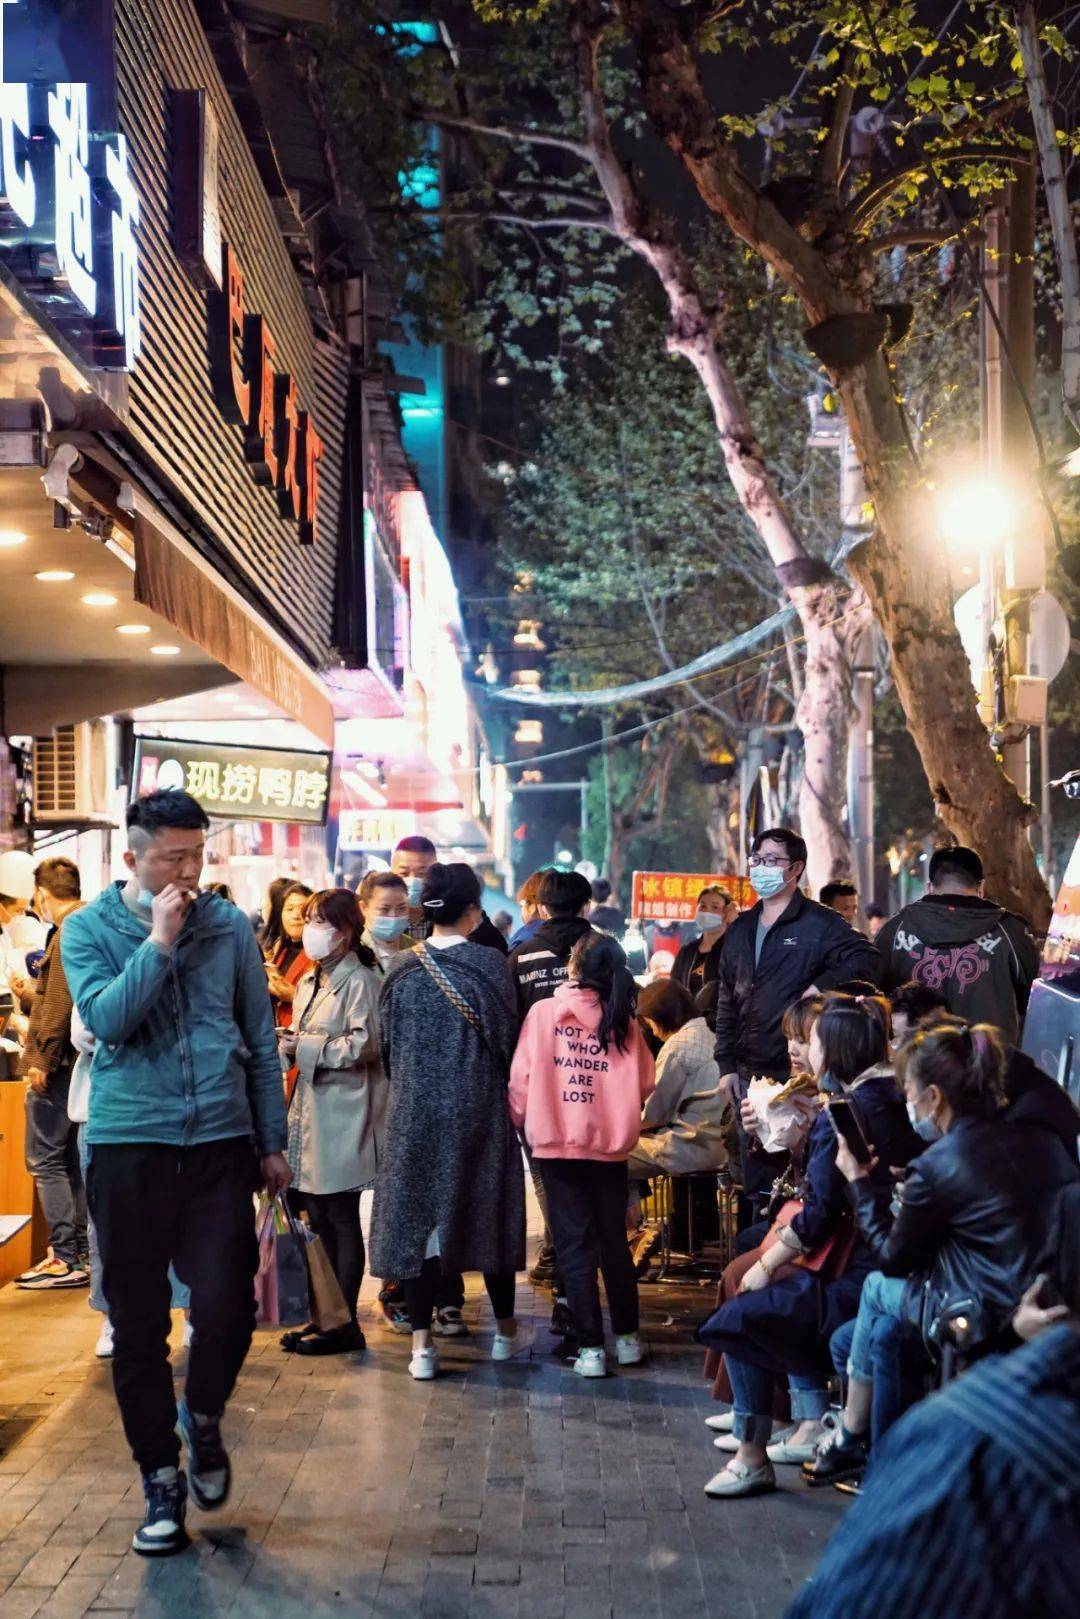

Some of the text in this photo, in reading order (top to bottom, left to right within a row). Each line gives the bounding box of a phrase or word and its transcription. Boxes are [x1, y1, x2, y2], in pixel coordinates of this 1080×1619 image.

[186, 761, 328, 809] 现捞鸭脖
[555, 1026, 583, 1038] NOT
[568, 1041, 600, 1055] WHO
[553, 1056, 609, 1073] WANDER
[568, 1074, 593, 1087] ARE
[563, 1091, 595, 1104] LOST
